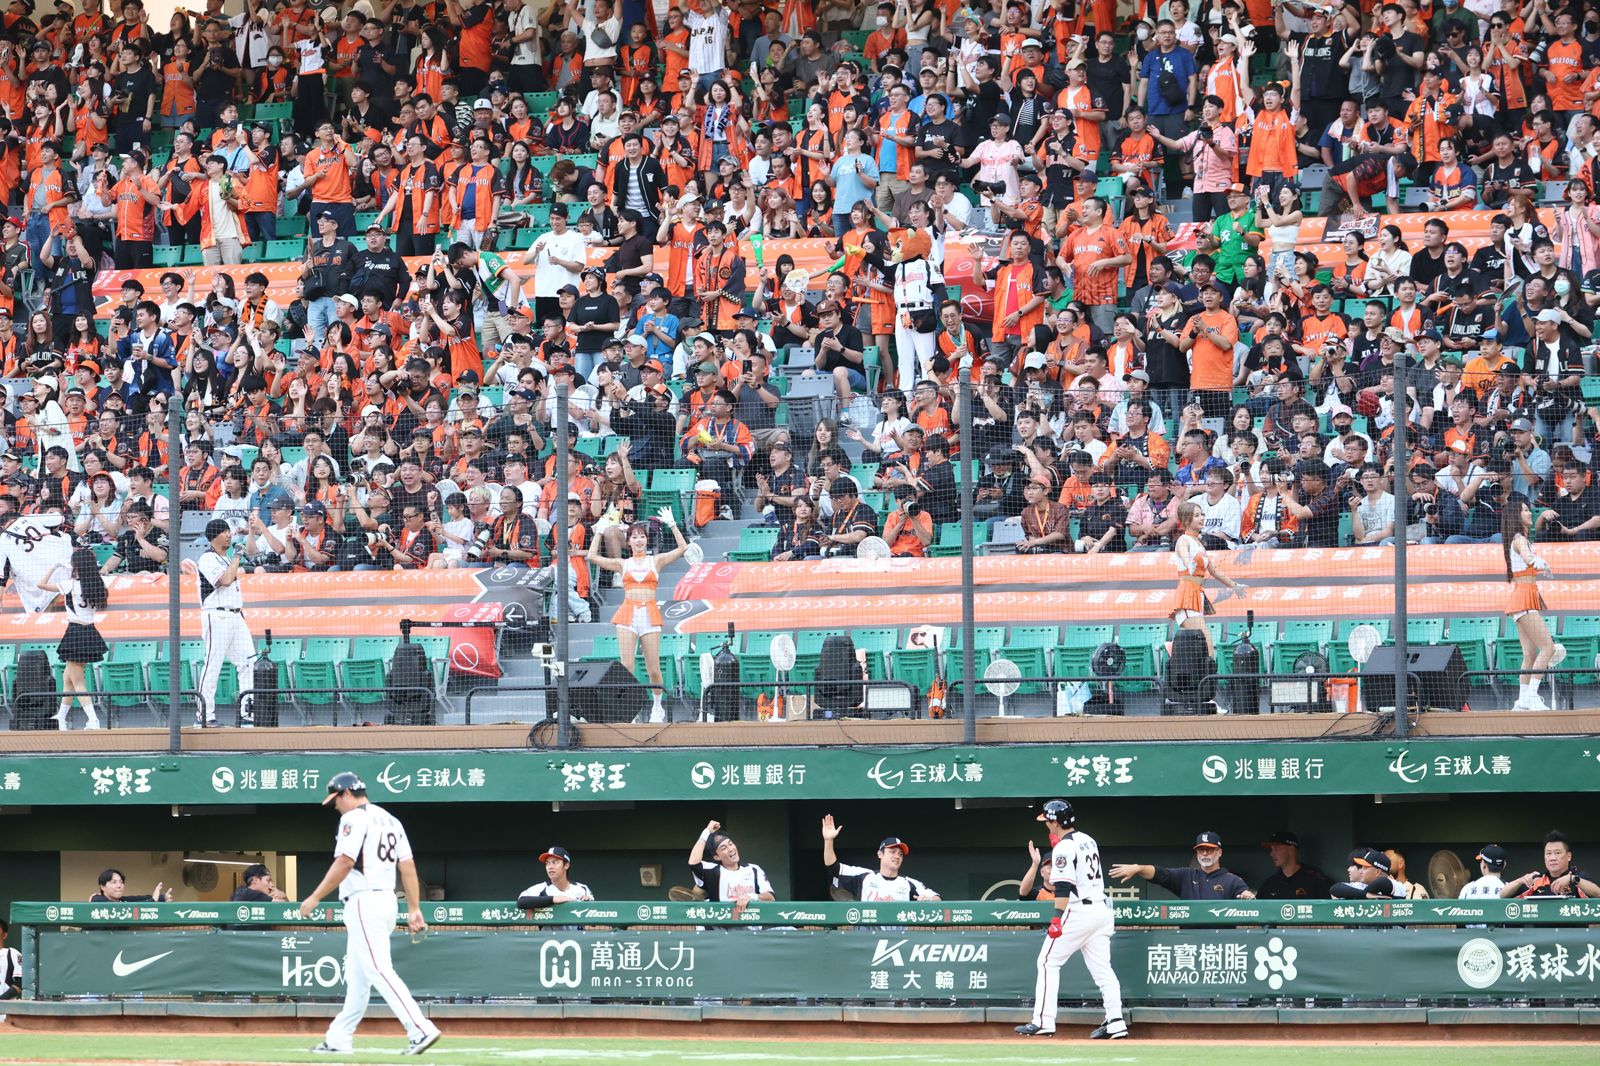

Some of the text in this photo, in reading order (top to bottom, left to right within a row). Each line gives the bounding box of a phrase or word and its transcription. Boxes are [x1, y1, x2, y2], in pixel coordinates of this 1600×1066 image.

[14, 525, 42, 552] 30
[722, 764, 806, 785] 兆豐銀行
[910, 763, 983, 783] 全球人壽
[1064, 755, 1132, 787] 茶裏王
[1235, 758, 1324, 779] 兆豐銀行
[1434, 755, 1512, 776] 全球人壽
[0, 772, 21, 790] 壽
[91, 766, 151, 796] 茶裏王
[240, 769, 320, 789] 兆豐銀行
[416, 767, 486, 786] 全球人壽
[561, 763, 626, 793] 茶裏王
[377, 831, 397, 863] 68
[1085, 852, 1102, 880] 32
[281, 937, 310, 949] 統一
[909, 944, 988, 962] KENDA
[591, 941, 695, 971] 萬通人力
[1147, 943, 1248, 971] 南寶樹脂
[1506, 944, 1600, 982] 環球水
[591, 976, 694, 987] MAN-STRONG
[870, 971, 988, 990] 建大輪胎
[1147, 970, 1248, 985] NANPAO RESINS
